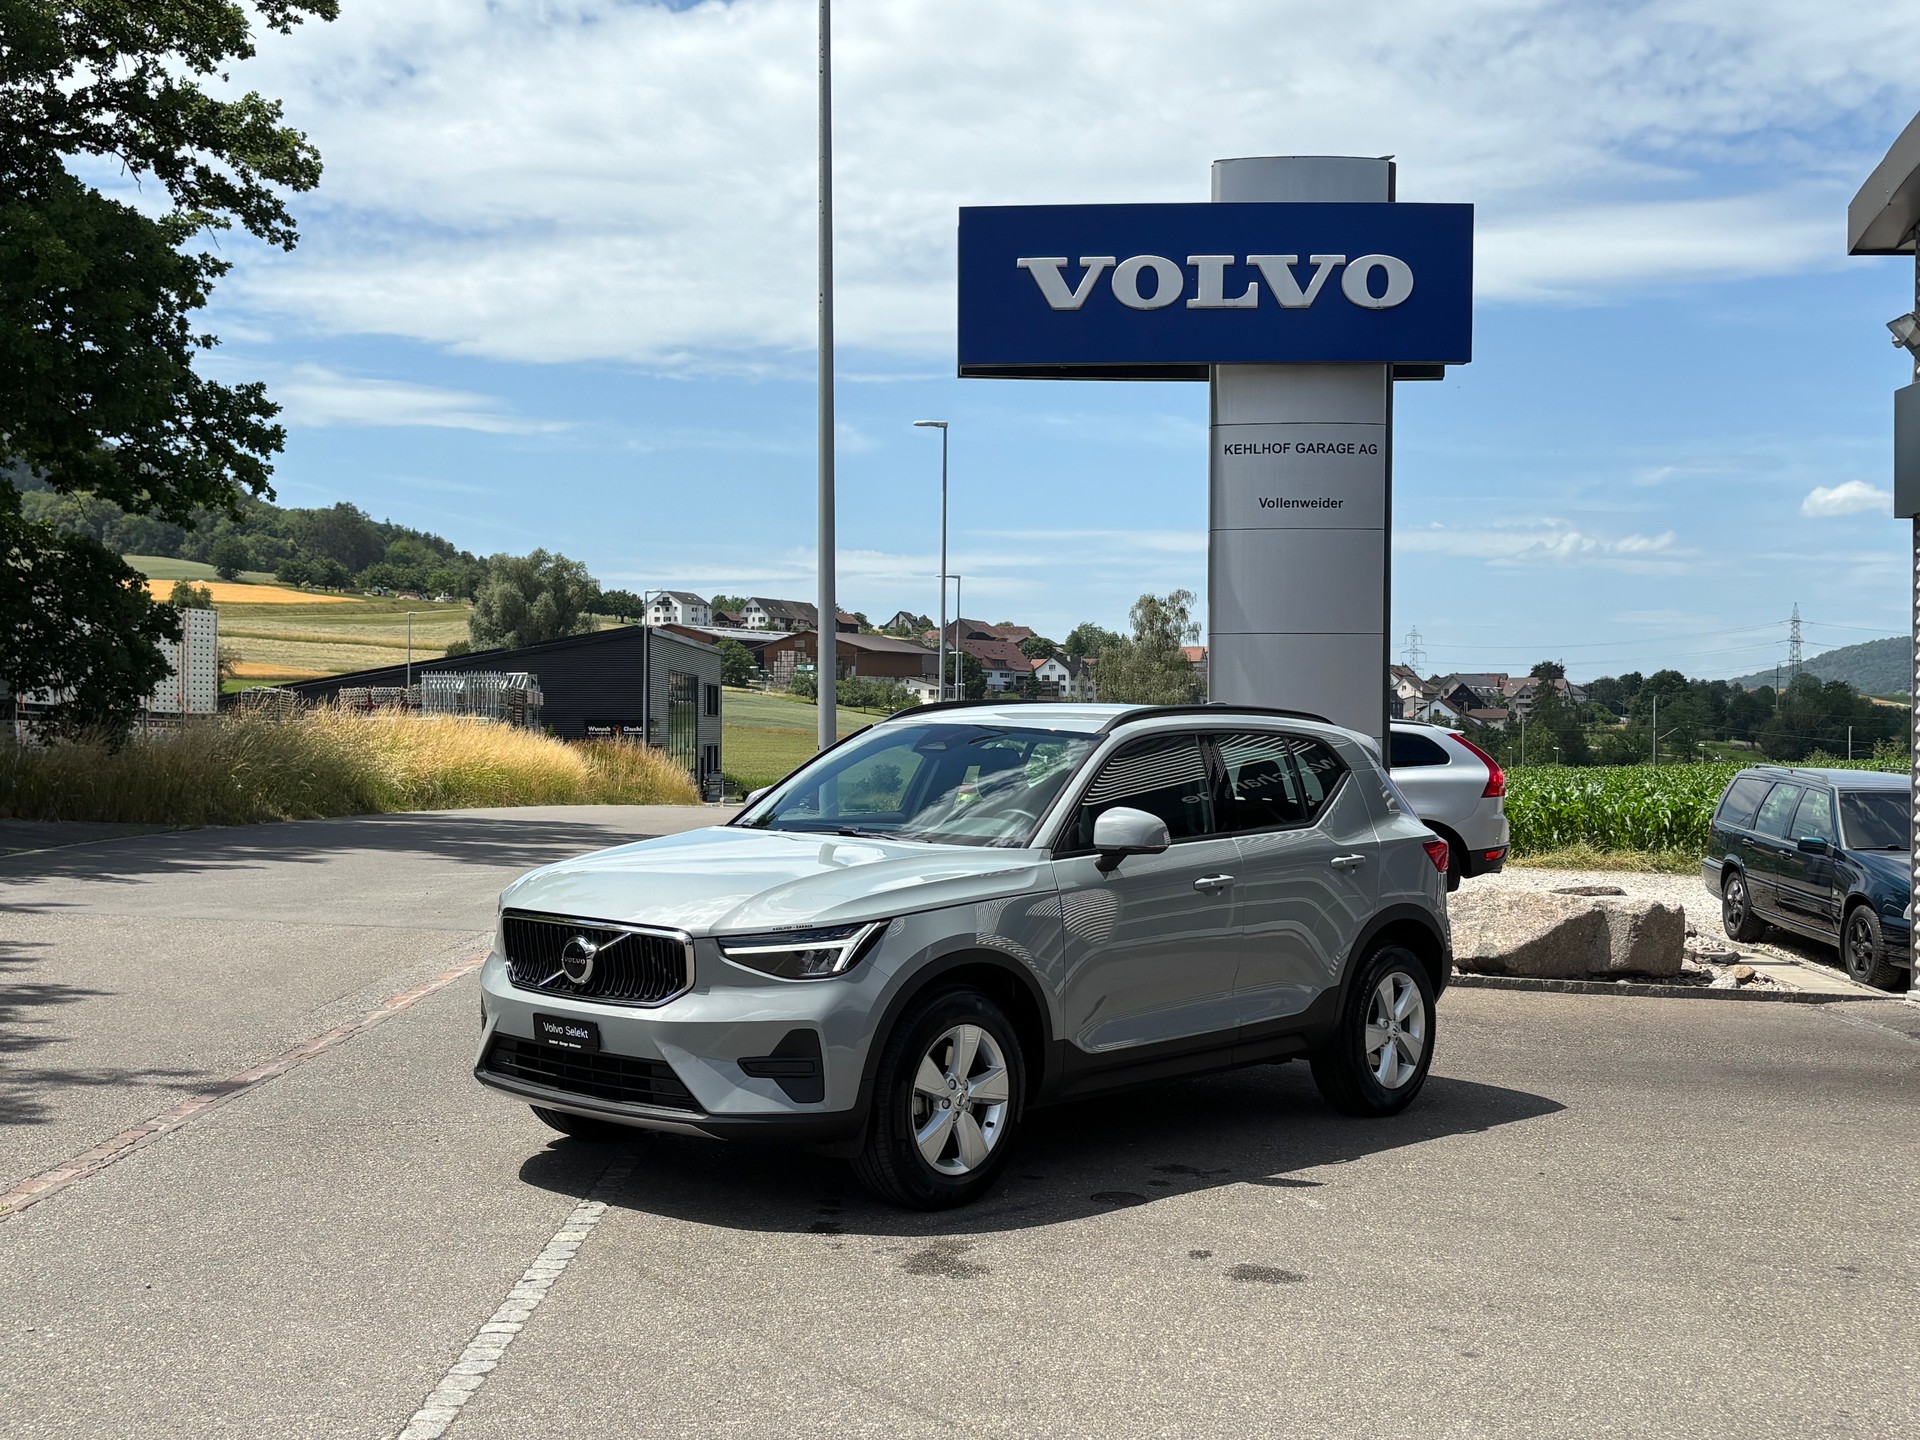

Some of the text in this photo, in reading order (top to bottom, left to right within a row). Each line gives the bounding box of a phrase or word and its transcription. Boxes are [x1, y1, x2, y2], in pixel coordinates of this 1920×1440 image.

[1017, 254, 1414, 311] VOLVO
[1224, 443, 1378, 455] KEHLHOF GARAGE AG
[1259, 498, 1344, 509] Vollenweider
[564, 956, 586, 965] VOLVO
[543, 1022, 589, 1039] Volvo Selekt
